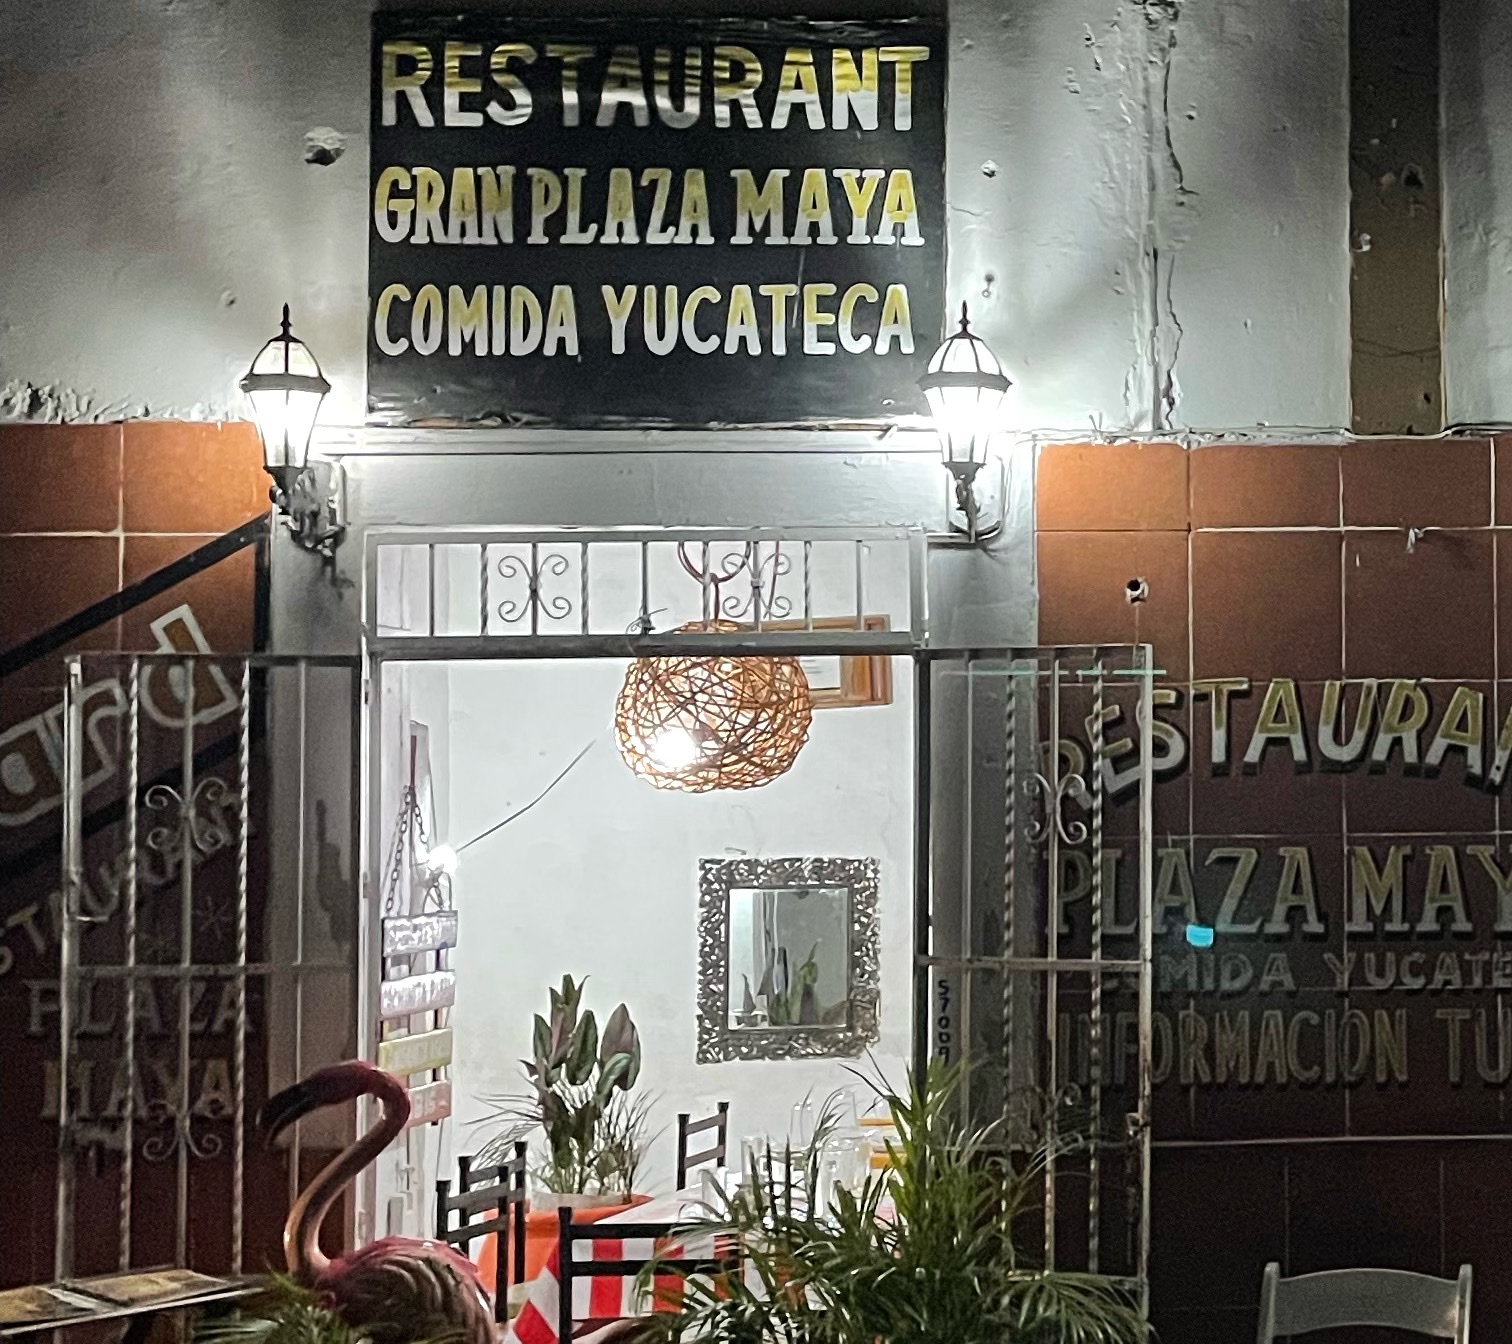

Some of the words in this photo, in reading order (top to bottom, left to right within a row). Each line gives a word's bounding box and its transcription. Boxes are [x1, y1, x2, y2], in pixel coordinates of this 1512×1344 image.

[380, 40, 930, 131] RESTAURANT
[374, 166, 515, 245] GRAN
[526, 167, 715, 246] PLAZA
[730, 168, 925, 247] MAYA
[374, 283, 578, 356] COMIDA
[602, 283, 914, 356] YUCATECA
[1043, 846, 1326, 935] PLAZA
[23, 978, 255, 1035] PLAZA
[1098, 951, 1297, 994] MIDA
[1057, 1009, 1408, 1087] INFORMACION
